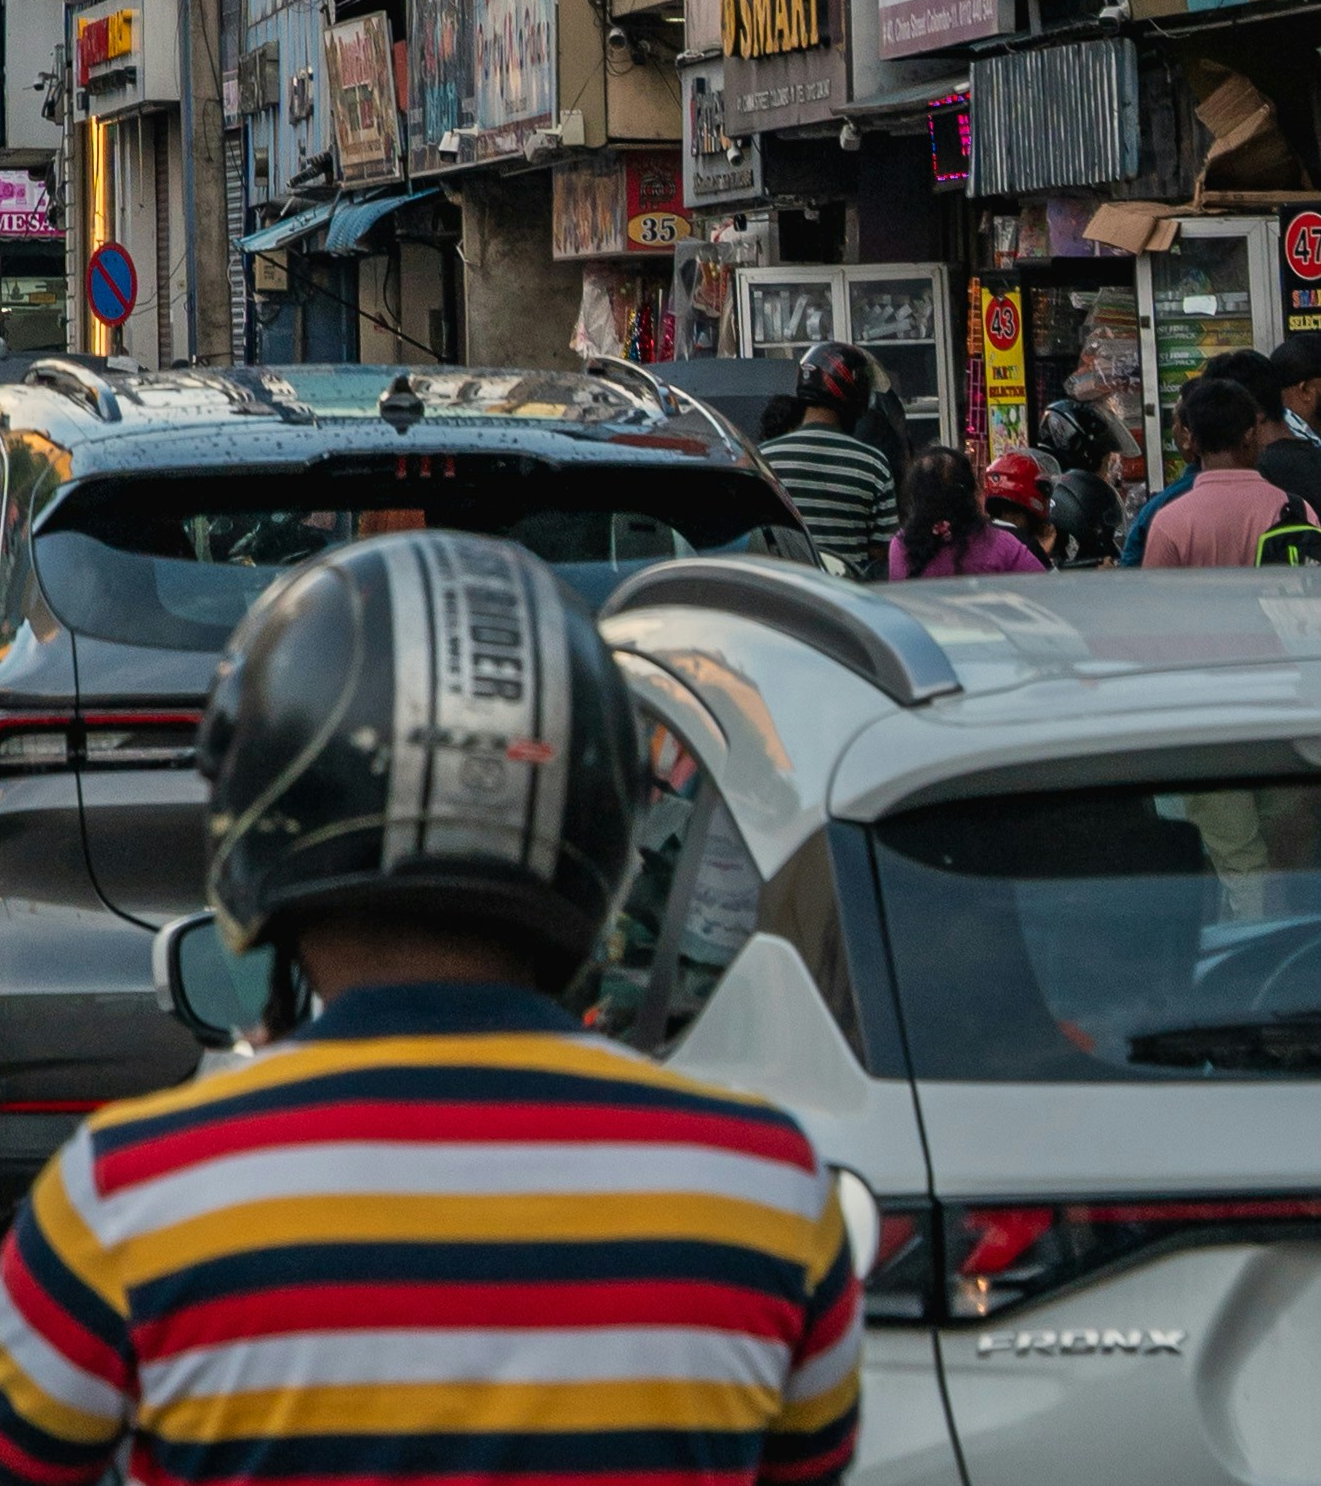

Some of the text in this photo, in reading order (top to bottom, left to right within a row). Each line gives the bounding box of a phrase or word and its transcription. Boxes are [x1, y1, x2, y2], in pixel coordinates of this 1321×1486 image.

[640, 216, 678, 242] 35
[990, 306, 1016, 340] 43
[992, 365, 1019, 381] PARTY
[976, 1328, 1190, 1358] FRONX
